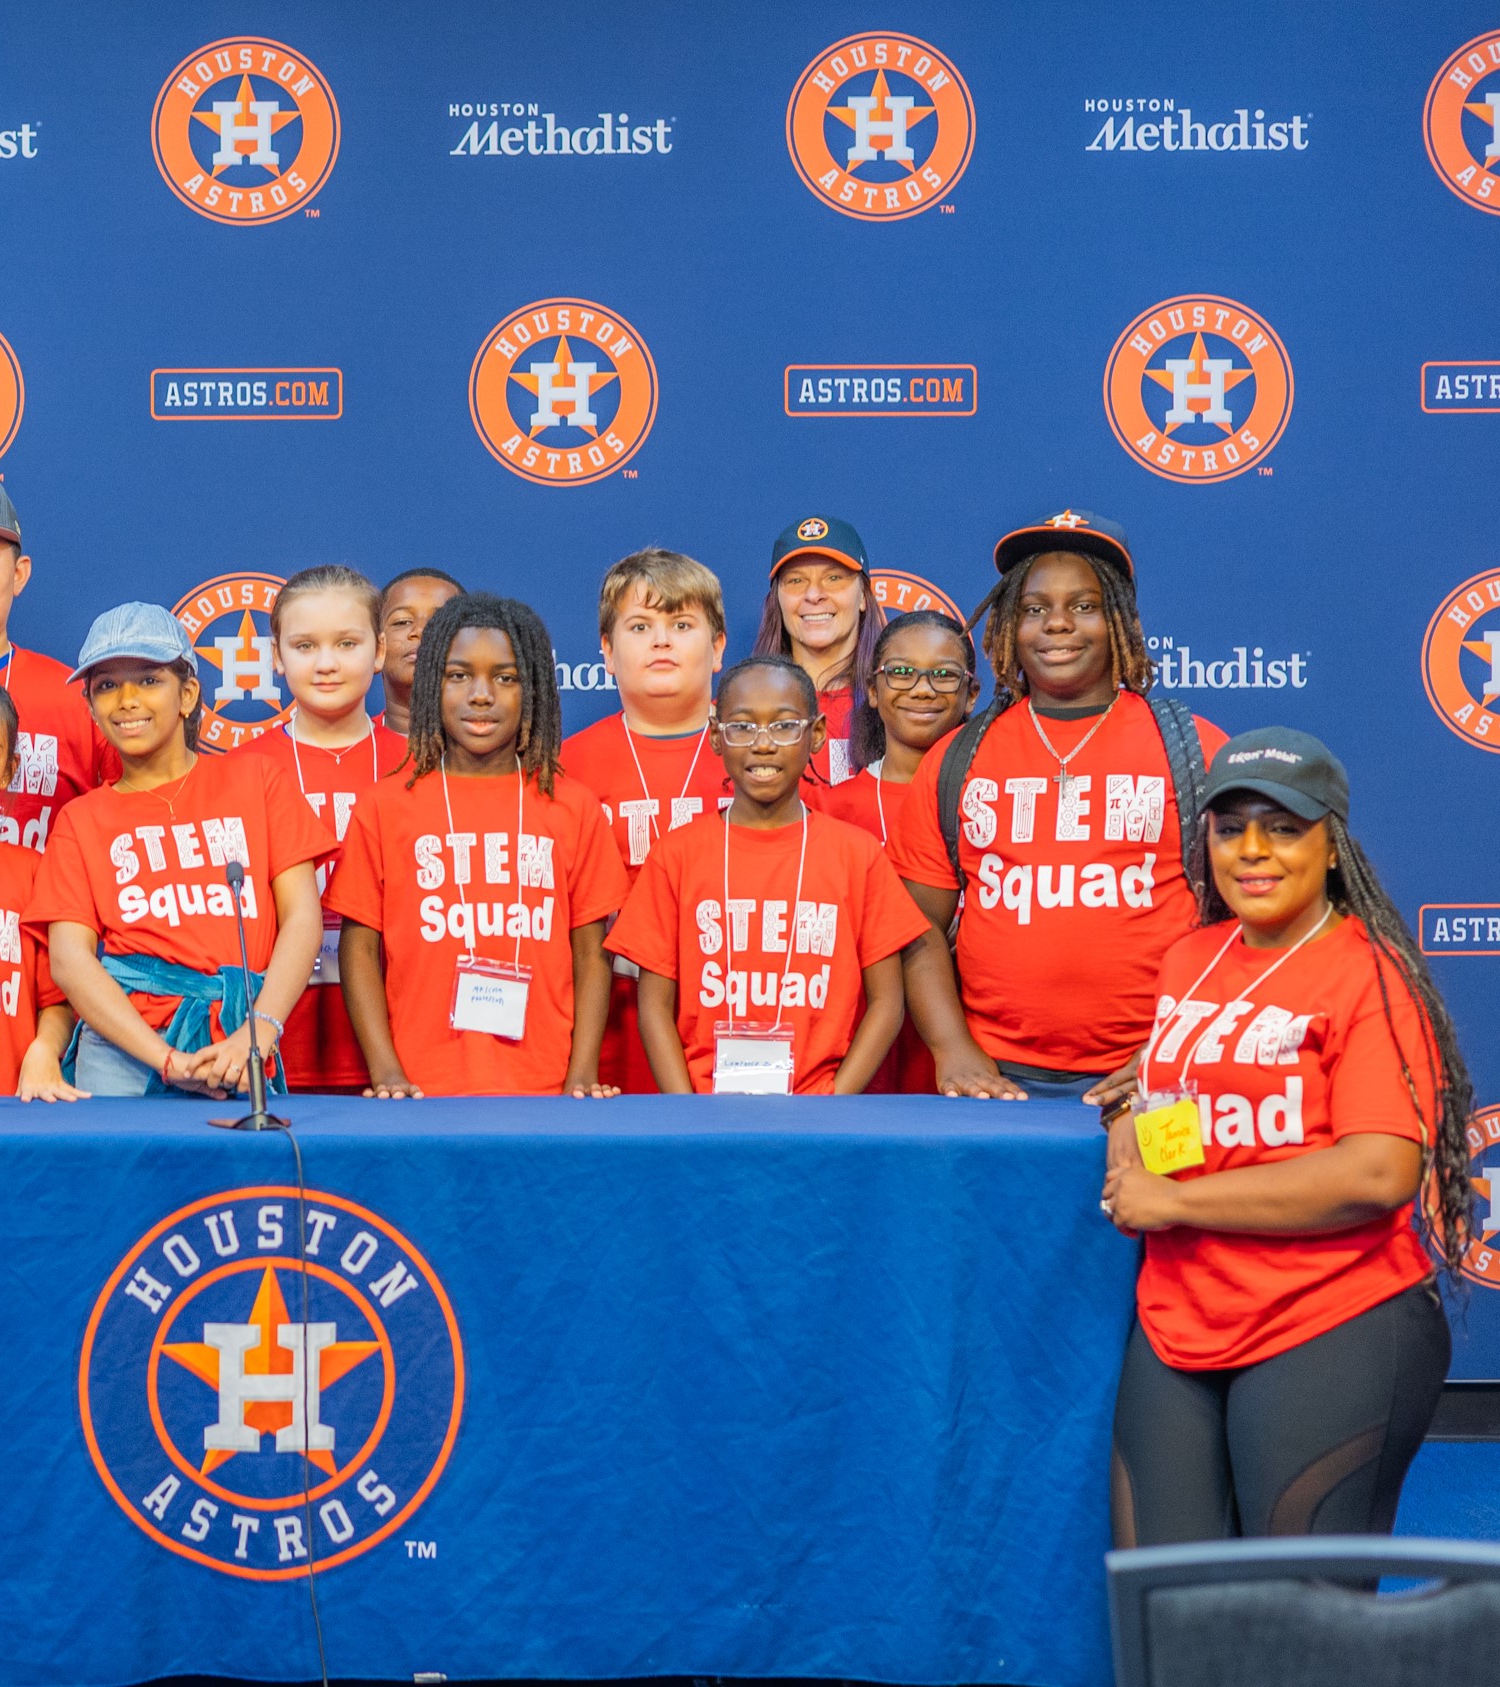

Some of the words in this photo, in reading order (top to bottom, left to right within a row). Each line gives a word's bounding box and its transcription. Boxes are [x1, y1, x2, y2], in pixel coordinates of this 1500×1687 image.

[178, 49, 314, 98] HOUSTON
[813, 43, 949, 93] HOUSTON
[449, 103, 539, 117] HOUSTON
[848, 96, 914, 161] H
[1085, 99, 1175, 112] HOUSTON
[1085, 109, 1309, 151] Methodist
[213, 101, 279, 166] H
[449, 113, 673, 156] Methodist
[184, 172, 306, 213] ASTROS
[819, 167, 941, 208] ASTROS
[495, 310, 632, 359] HOUSTON
[1130, 306, 1268, 356] HOUSTON
[164, 381, 329, 407] ASTROS.COM
[531, 361, 597, 427] H
[798, 378, 963, 403] ASTROS.COM
[1166, 358, 1232, 423] H
[502, 433, 624, 474] ASTROS
[1136, 430, 1259, 471] ASTROS
[179, 583, 277, 634] HOUST
[214, 636, 281, 700] H
[1140, 646, 1307, 689] thodist
[962, 774, 1165, 850] STEM
[109, 816, 251, 885] STEM
[414, 832, 555, 890] STEM
[117, 874, 259, 928] Squad
[978, 852, 1157, 926] Squad
[419, 895, 555, 949] Squad
[695, 899, 839, 958] STEM
[699, 960, 831, 1018] Squad
[124, 1205, 418, 1314] HOUSTON
[203, 1322, 337, 1452] H
[142, 1469, 396, 1562] ASTROS
[404, 1541, 437, 1559] TM
